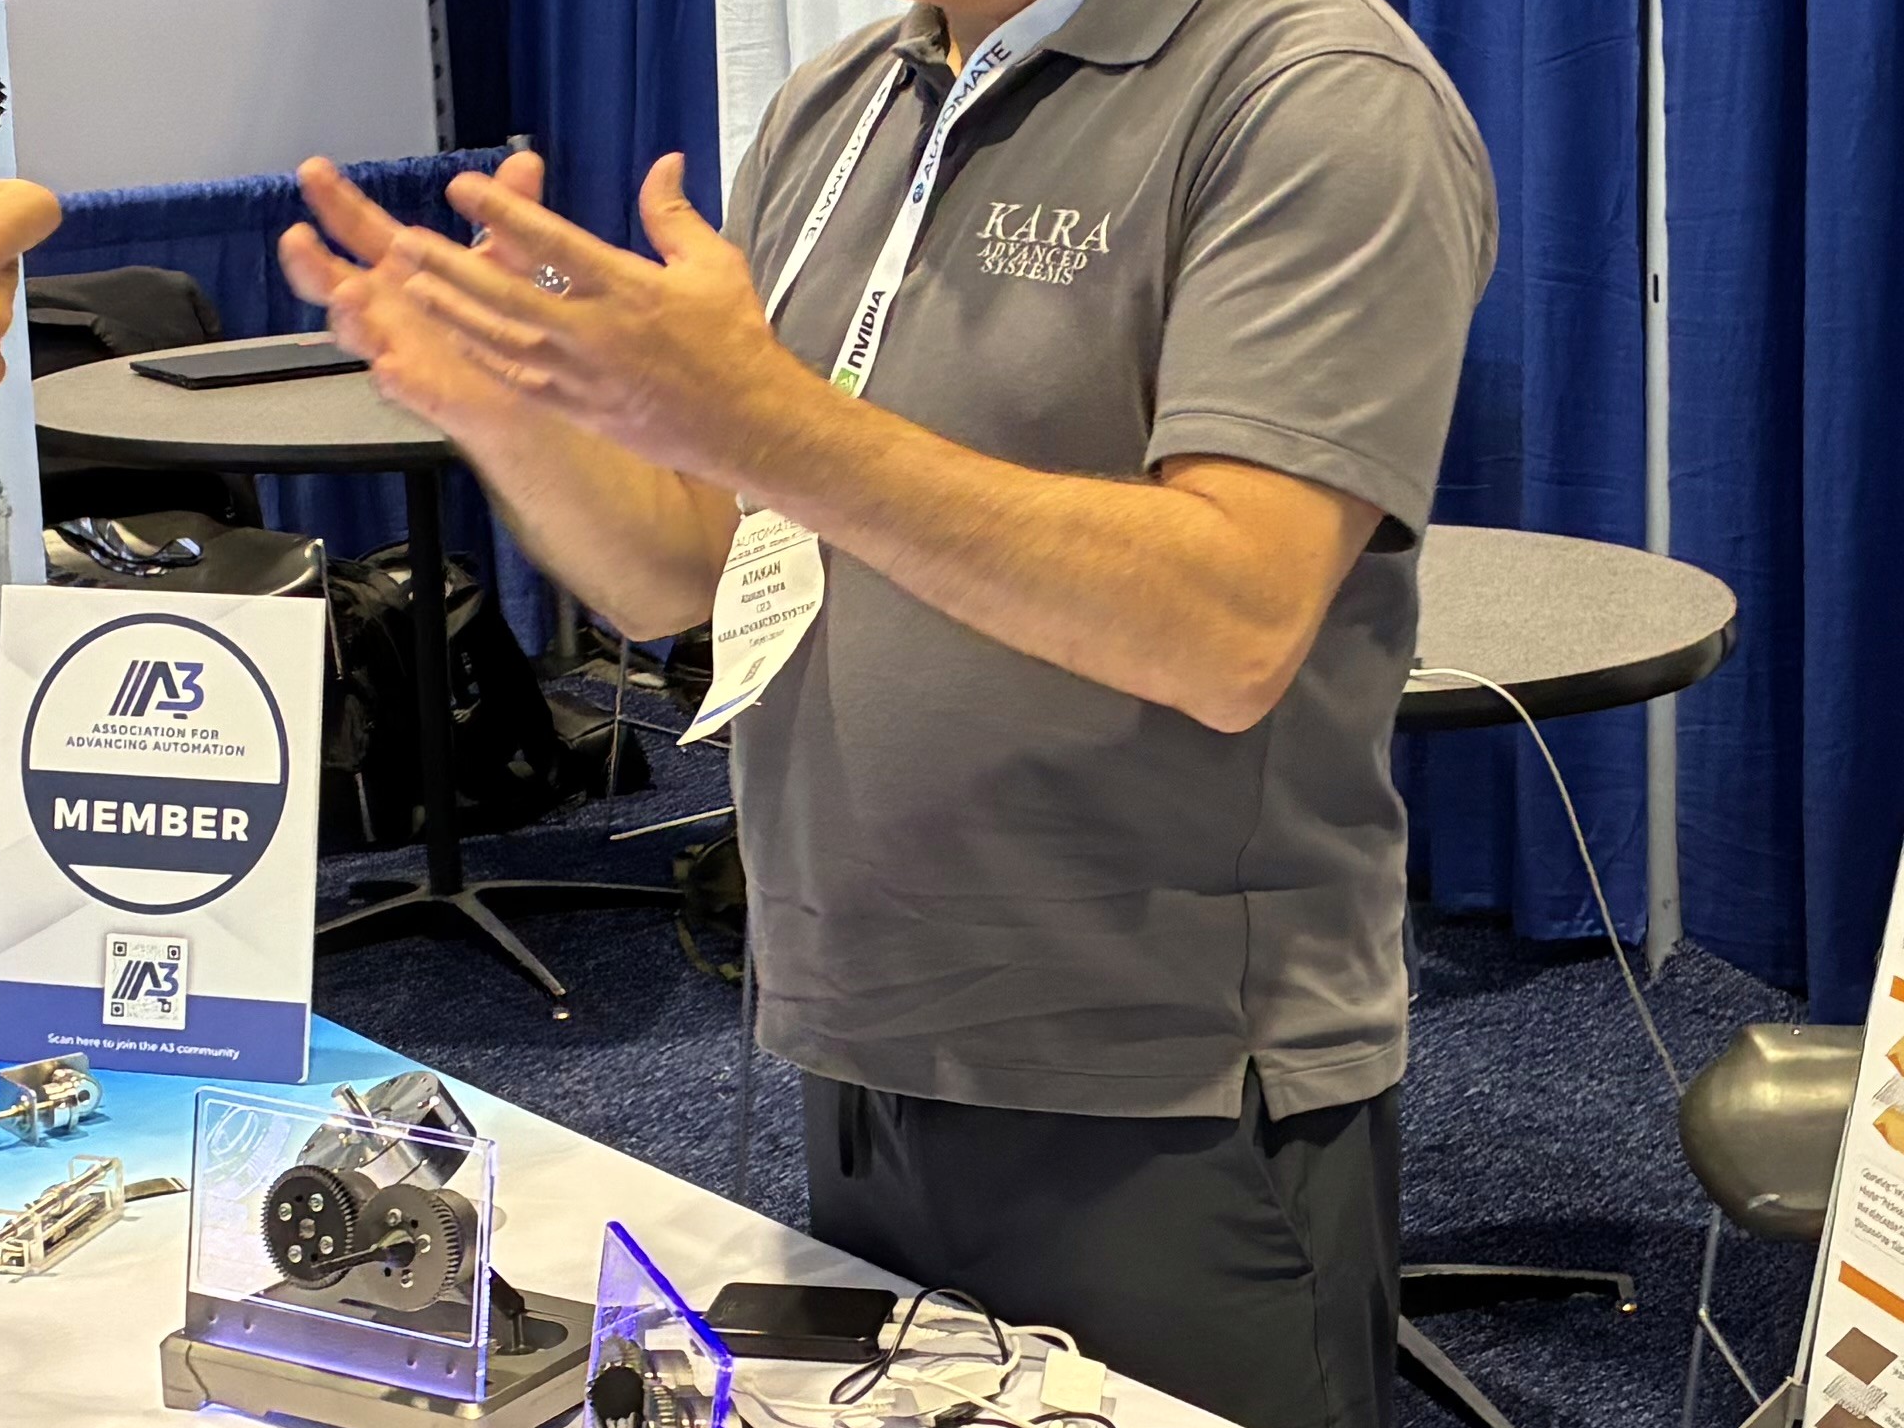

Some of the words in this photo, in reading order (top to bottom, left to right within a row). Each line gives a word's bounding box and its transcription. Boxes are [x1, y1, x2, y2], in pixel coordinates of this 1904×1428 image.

[976, 202, 1111, 254] KARA
[977, 241, 1088, 270] ADVANCED
[981, 257, 1074, 285] SYSTEMS
[91, 723, 186, 739] ASSOCIATION
[191, 729, 219, 740] FOR
[66, 736, 147, 751] ADVANCING
[152, 741, 246, 757] AUTOMATION
[53, 797, 249, 842] MEMBER
[47, 1033, 75, 1045] Scan
[75, 1036, 100, 1048] here
[102, 1038, 114, 1048] to
[115, 1039, 137, 1051] join
[139, 1041, 157, 1052] the
[176, 1045, 241, 1060] community
